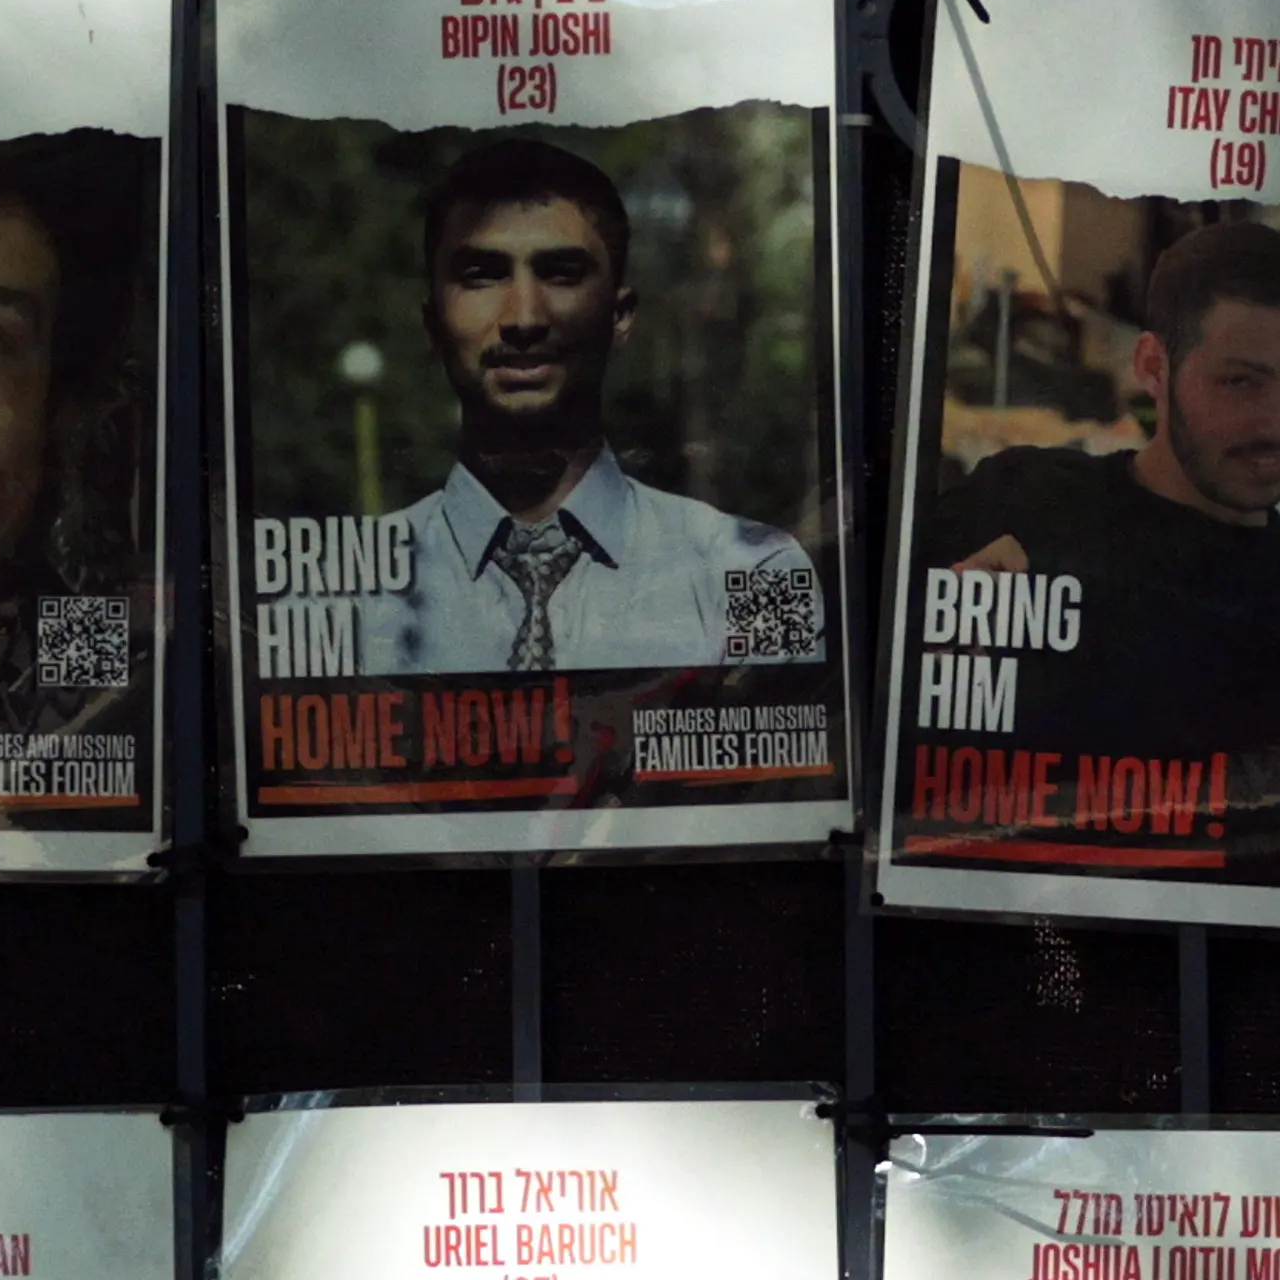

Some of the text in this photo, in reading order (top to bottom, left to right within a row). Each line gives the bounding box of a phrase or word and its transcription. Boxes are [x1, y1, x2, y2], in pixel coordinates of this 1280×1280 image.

[443, 13, 610, 58] BIPIN JOSHI
[1192, 36, 1222, 82] חן
[498, 66, 556, 113] (23)
[1168, 86, 1230, 131] ITAY
[1210, 140, 1266, 188] (19)
[255, 517, 412, 595] BRING
[257, 603, 357, 679] HIM
[260, 676, 573, 772] HOME NOW!
[26, 735, 59, 759] AND
[62, 735, 135, 759] MISSING
[52, 761, 135, 796] FORUM
[441, 1169, 618, 1219] אוריאל ברוך
[1053, 1190, 1122, 1235] מולל
[1136, 1194, 1231, 1236] לואיטו
[424, 1224, 637, 1268] URIEL BARUCH
